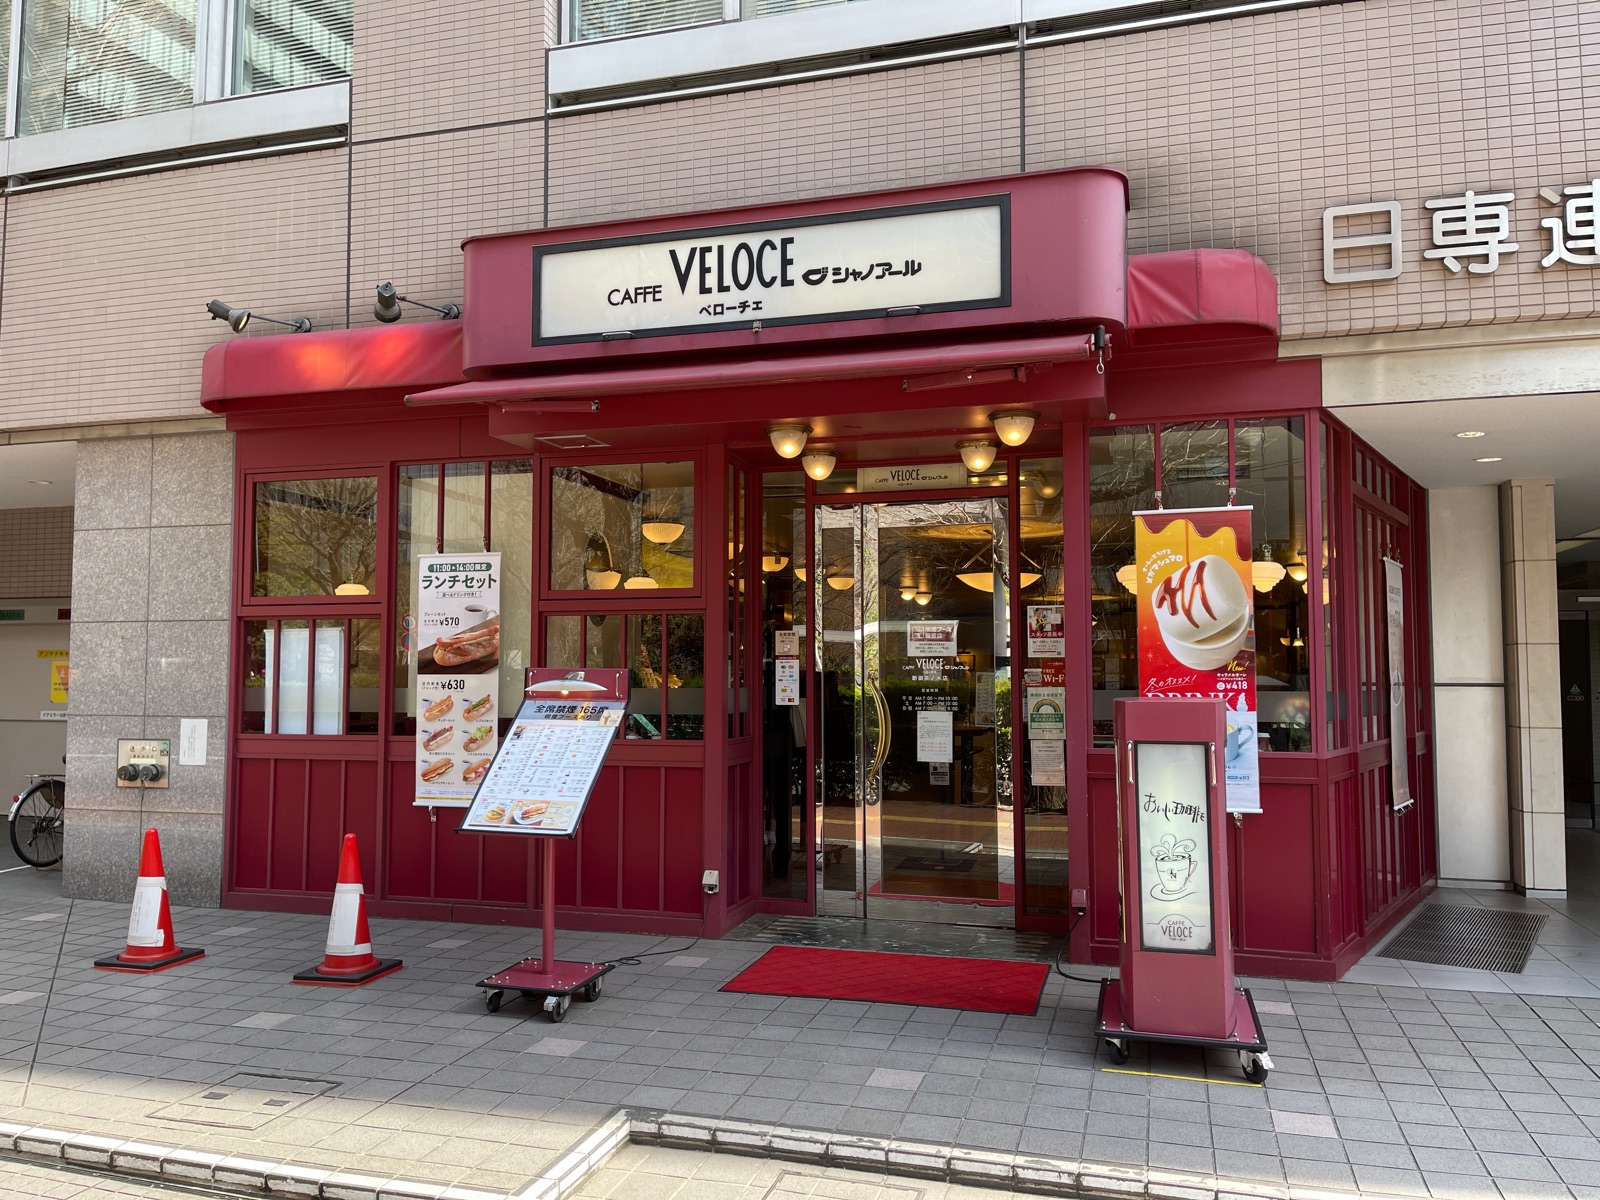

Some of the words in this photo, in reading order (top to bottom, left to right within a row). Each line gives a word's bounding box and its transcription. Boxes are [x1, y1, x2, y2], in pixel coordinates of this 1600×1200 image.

[607, 283, 662, 307] CAFFE
[668, 236, 796, 296] VELOCE
[831, 259, 922, 285] シャノアール
[698, 300, 763, 318] ベローチェ
[890, 469, 920, 482] VELOCE
[433, 564, 451, 572] 11:00
[1146, 555, 1184, 584] メガマシュマロ
[422, 573, 497, 590] ランチセット
[916, 658, 944, 670] VELOCE
[440, 679, 465, 691] ¥630
[1226, 681, 1248, 690] ¥418
[533, 704, 578, 714] 全席禁煙
[1161, 925, 1193, 938] VELOCE
